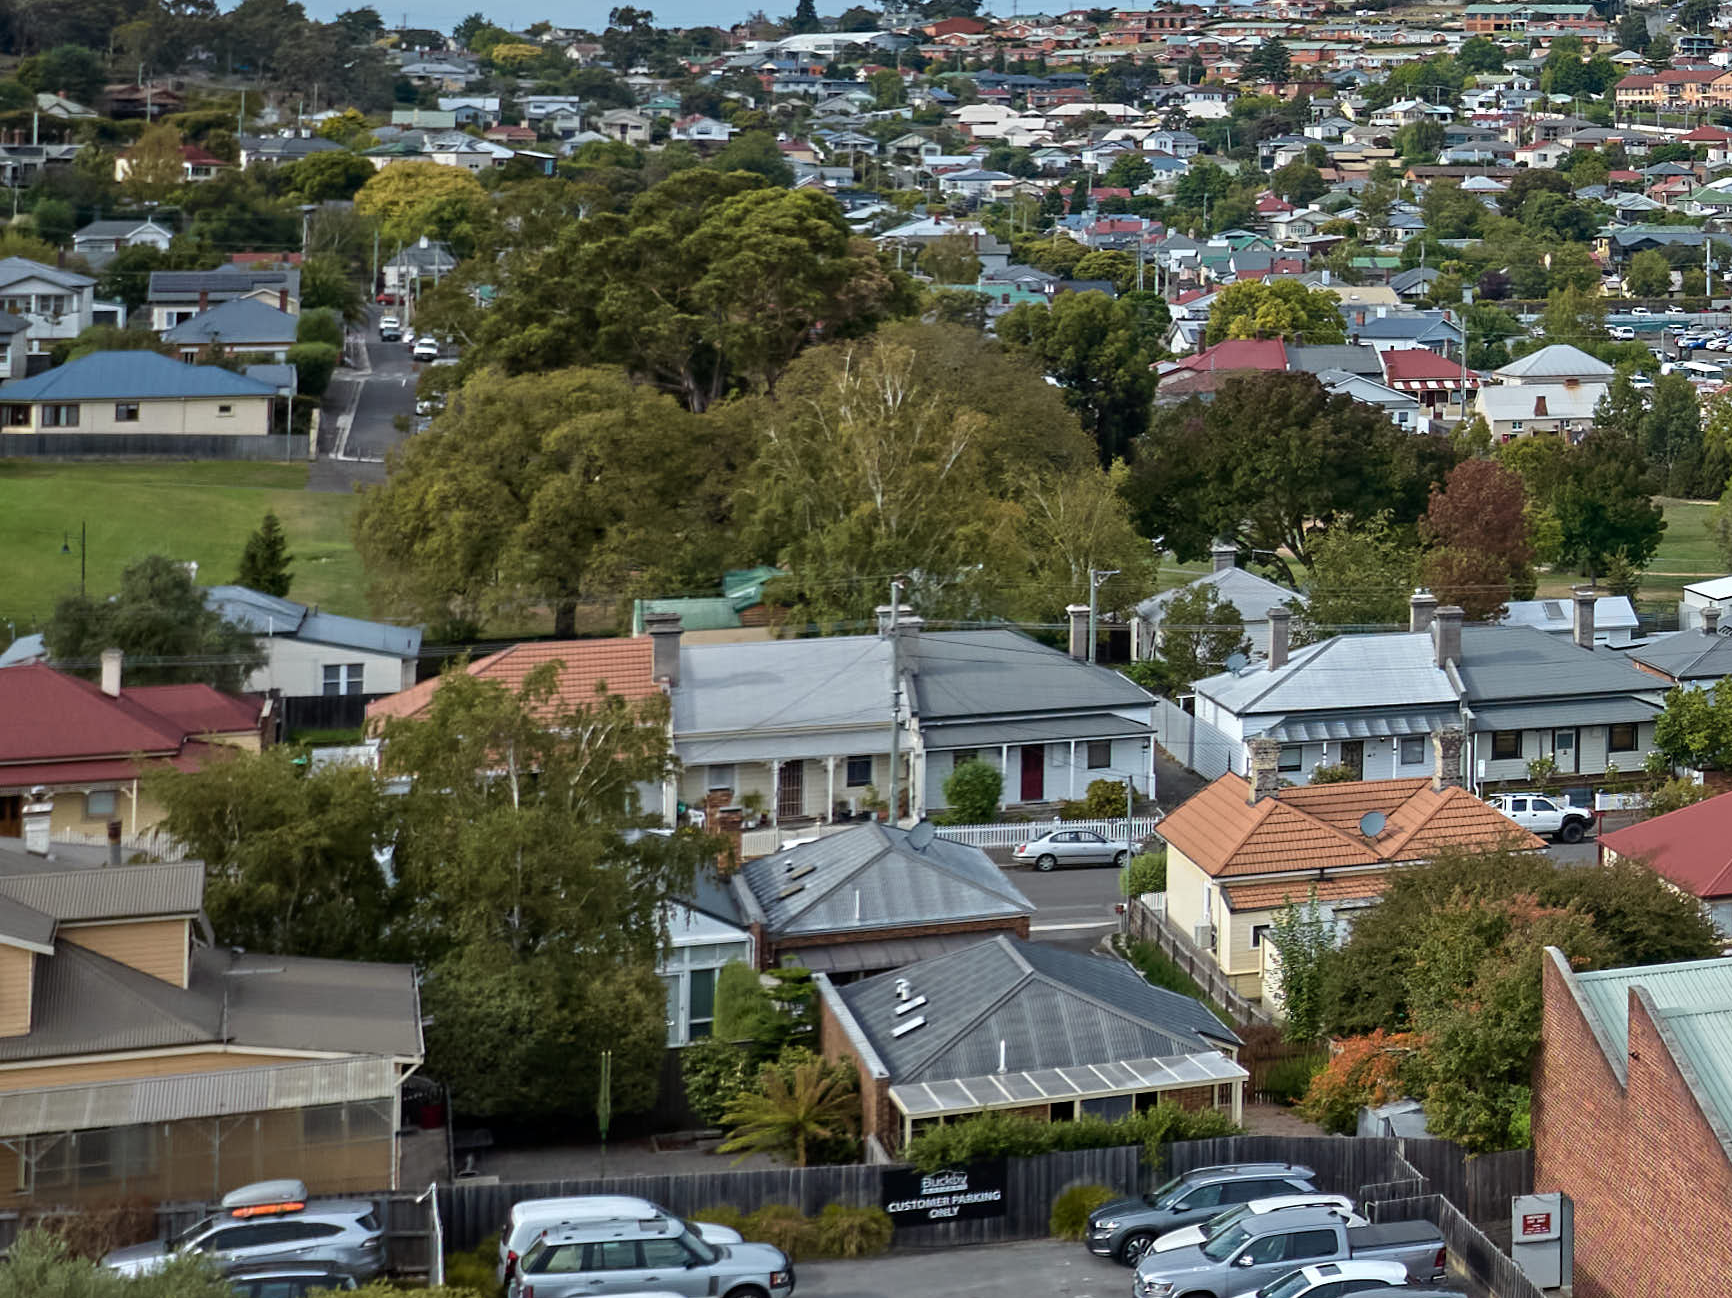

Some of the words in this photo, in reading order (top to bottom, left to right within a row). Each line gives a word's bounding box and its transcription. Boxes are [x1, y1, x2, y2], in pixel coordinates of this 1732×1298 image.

[922, 1174, 968, 1188] Buckby
[887, 1196, 950, 1213] CUSTOMER
[951, 1190, 1001, 1205] PARKING
[928, 1206, 960, 1219] ONLY
